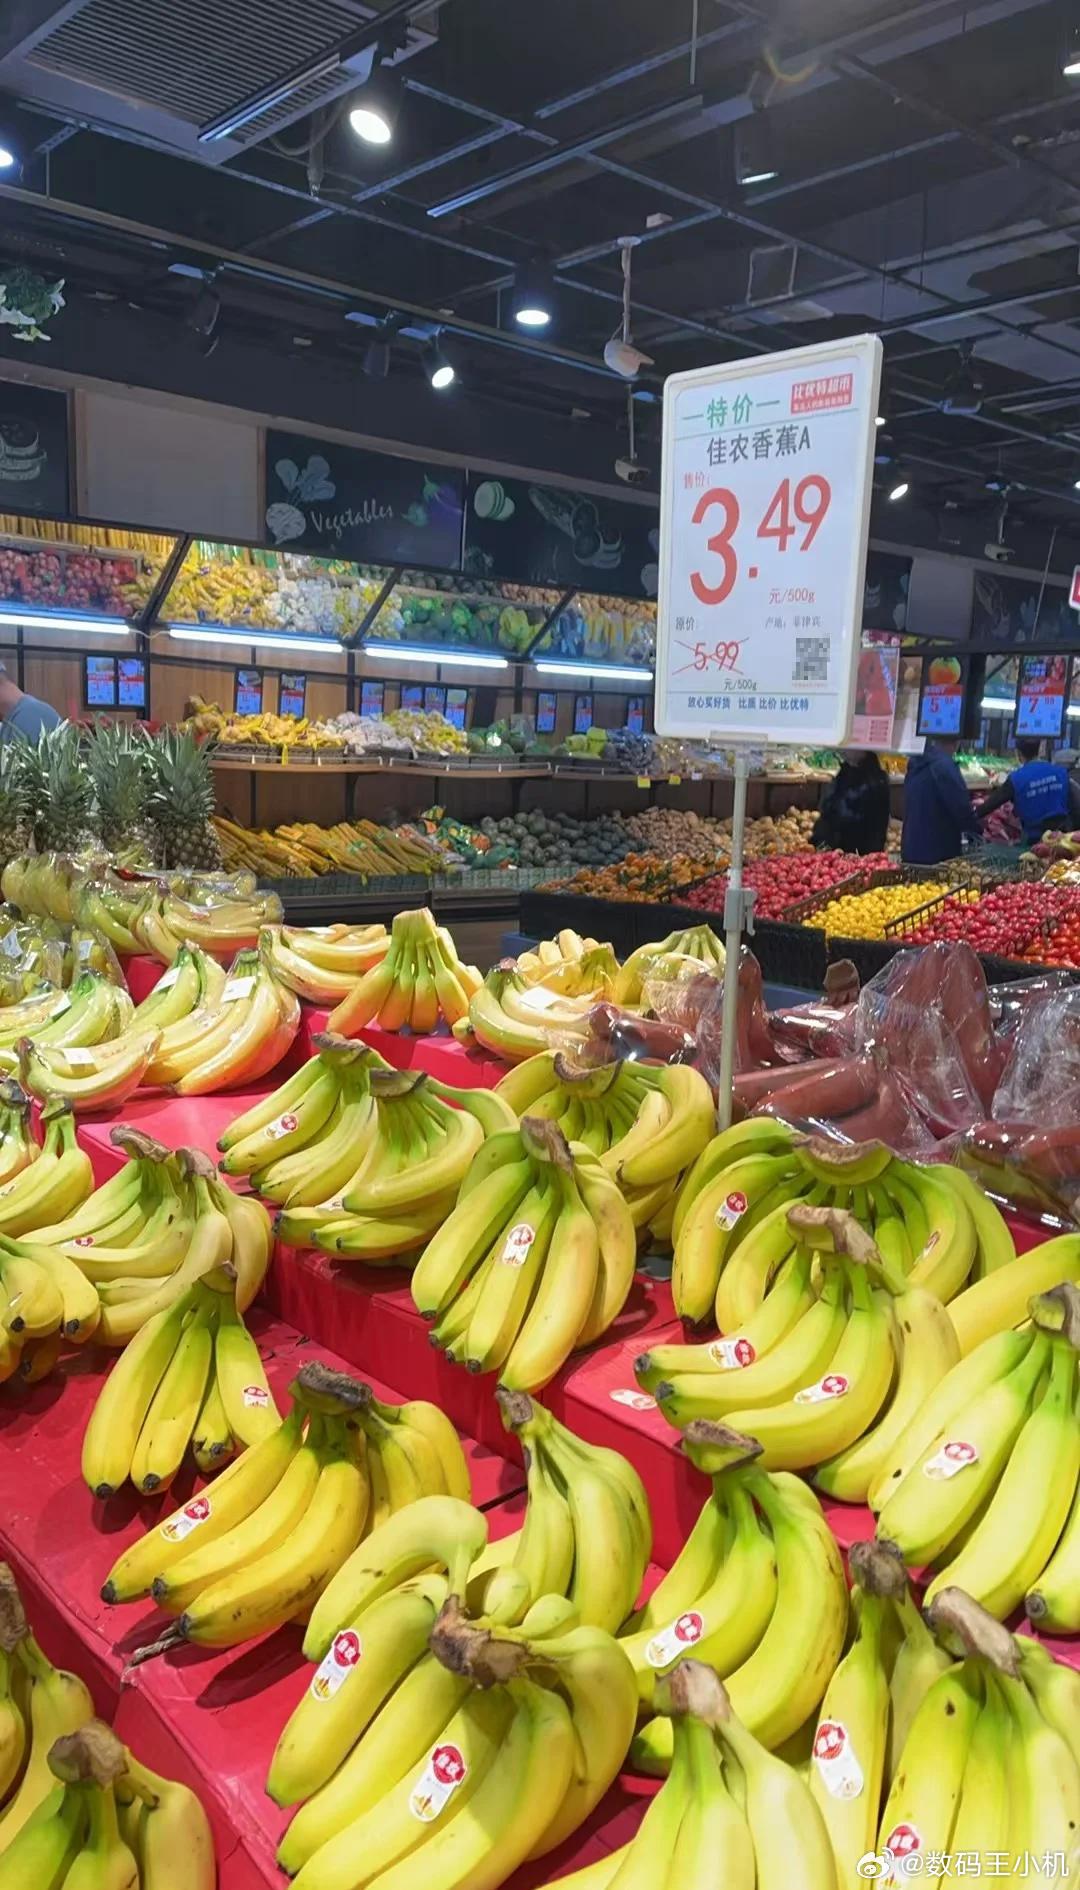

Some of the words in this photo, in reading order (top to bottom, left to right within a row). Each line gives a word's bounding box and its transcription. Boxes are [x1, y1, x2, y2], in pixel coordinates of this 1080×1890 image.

[707, 393, 753, 428] 特价
[707, 424, 811, 466] 佳农香蕉A
[310, 499, 393, 539] Vegetables
[769, 588, 816, 604] 元/500g
[694, 641, 739, 671] 5.99
[724, 678, 758, 691] 元/500g
